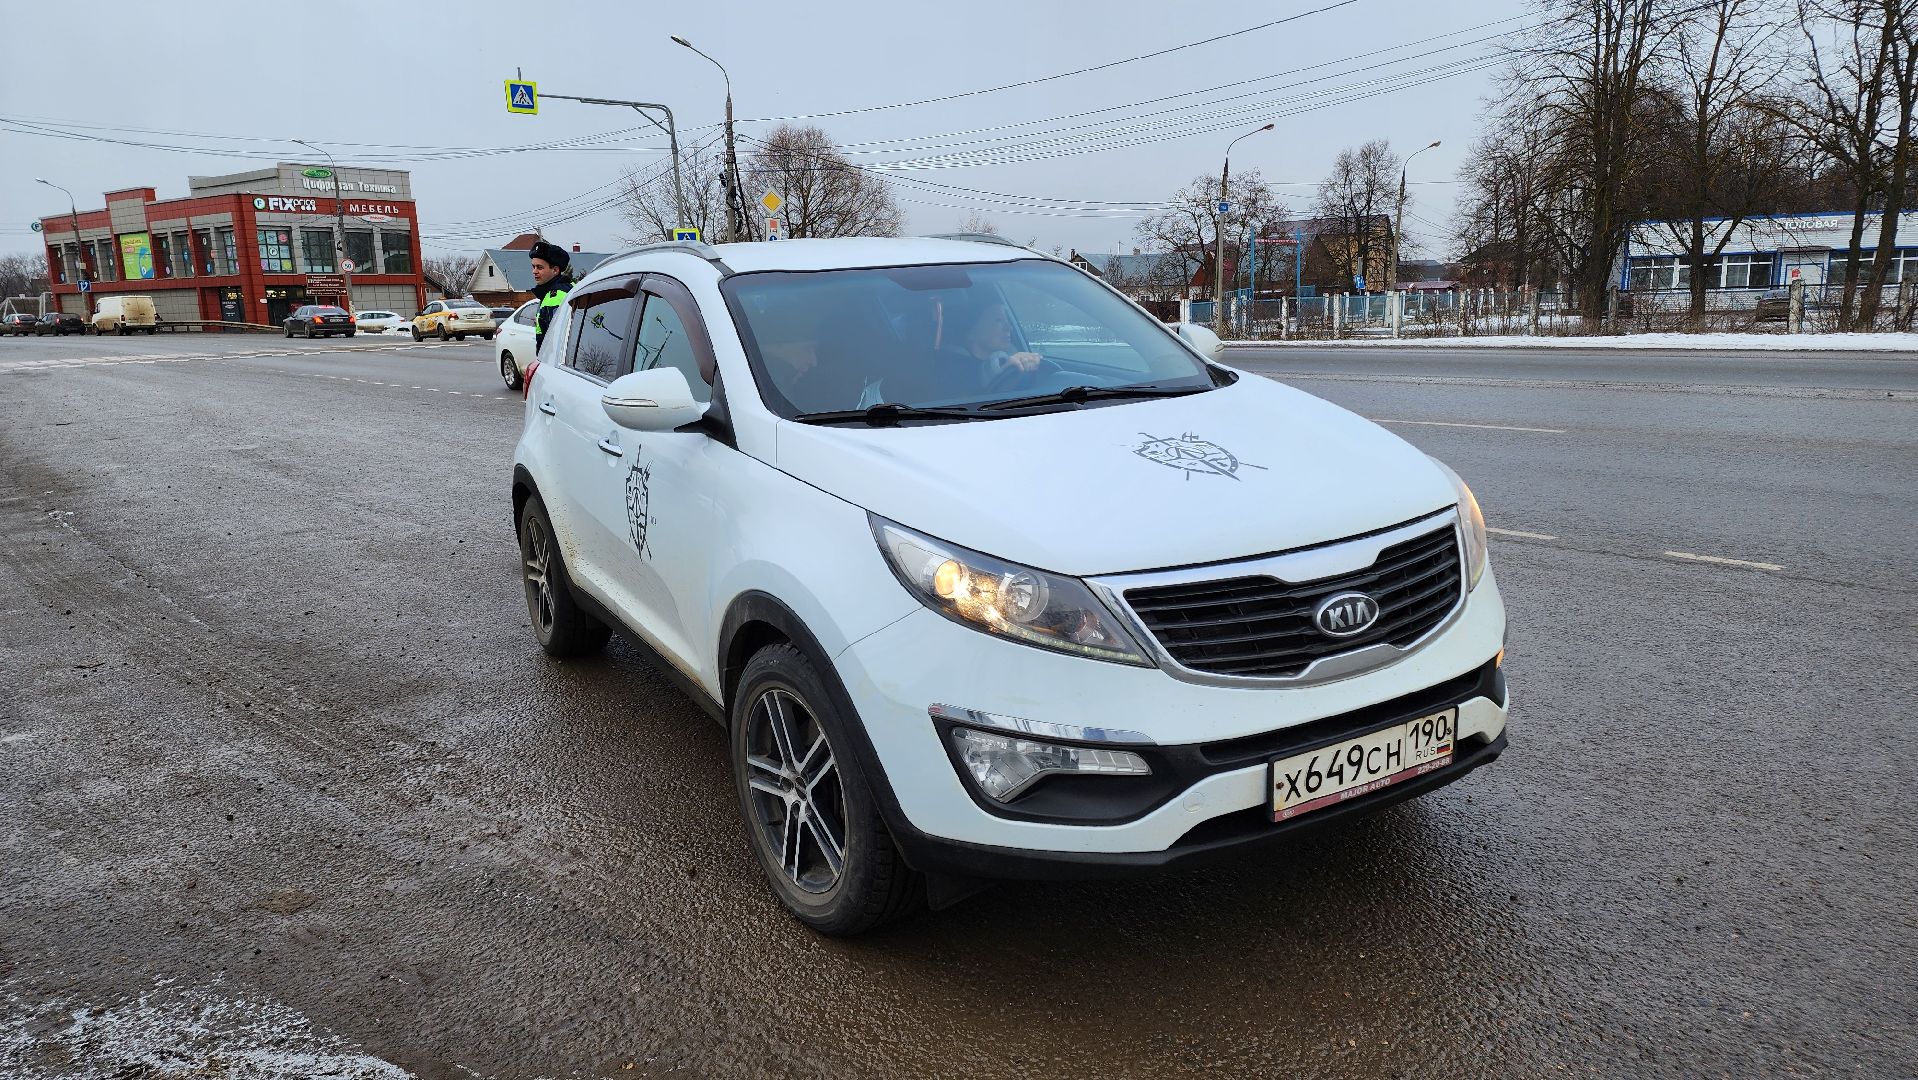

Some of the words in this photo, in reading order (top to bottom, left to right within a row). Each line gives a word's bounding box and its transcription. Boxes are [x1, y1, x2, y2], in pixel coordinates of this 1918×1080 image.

[268, 197, 295, 211] FIX
[349, 203, 399, 214] МЕБЕЛЬ
[1776, 219, 1838, 230] СТОЛОВАЯ
[1327, 601, 1371, 630] KIA
[1409, 715, 1448, 750] 190
[1415, 746, 1436, 760] RUS
[1340, 785, 1369, 800] MAJOR
[1370, 778, 1391, 791] AUTO
